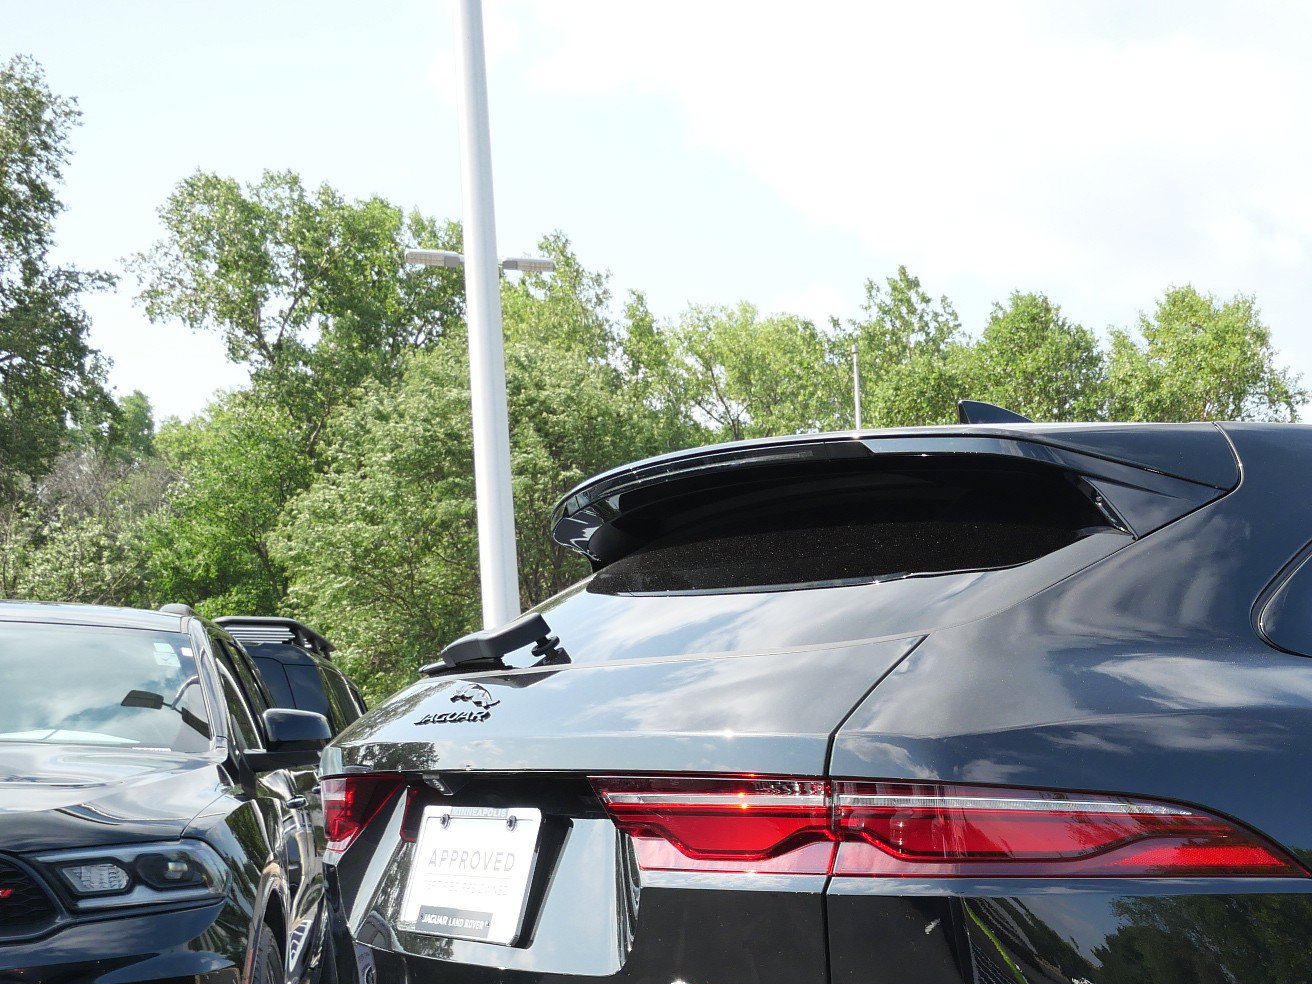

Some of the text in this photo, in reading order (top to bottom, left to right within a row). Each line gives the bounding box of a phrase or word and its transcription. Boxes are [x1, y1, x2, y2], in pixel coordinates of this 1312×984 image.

[413, 711, 491, 726] JAGUAR
[451, 806, 508, 817] MINNEAPOLIS
[427, 849, 515, 872] APPROVED
[421, 913, 485, 930] JAGUAR LAND ROVER
